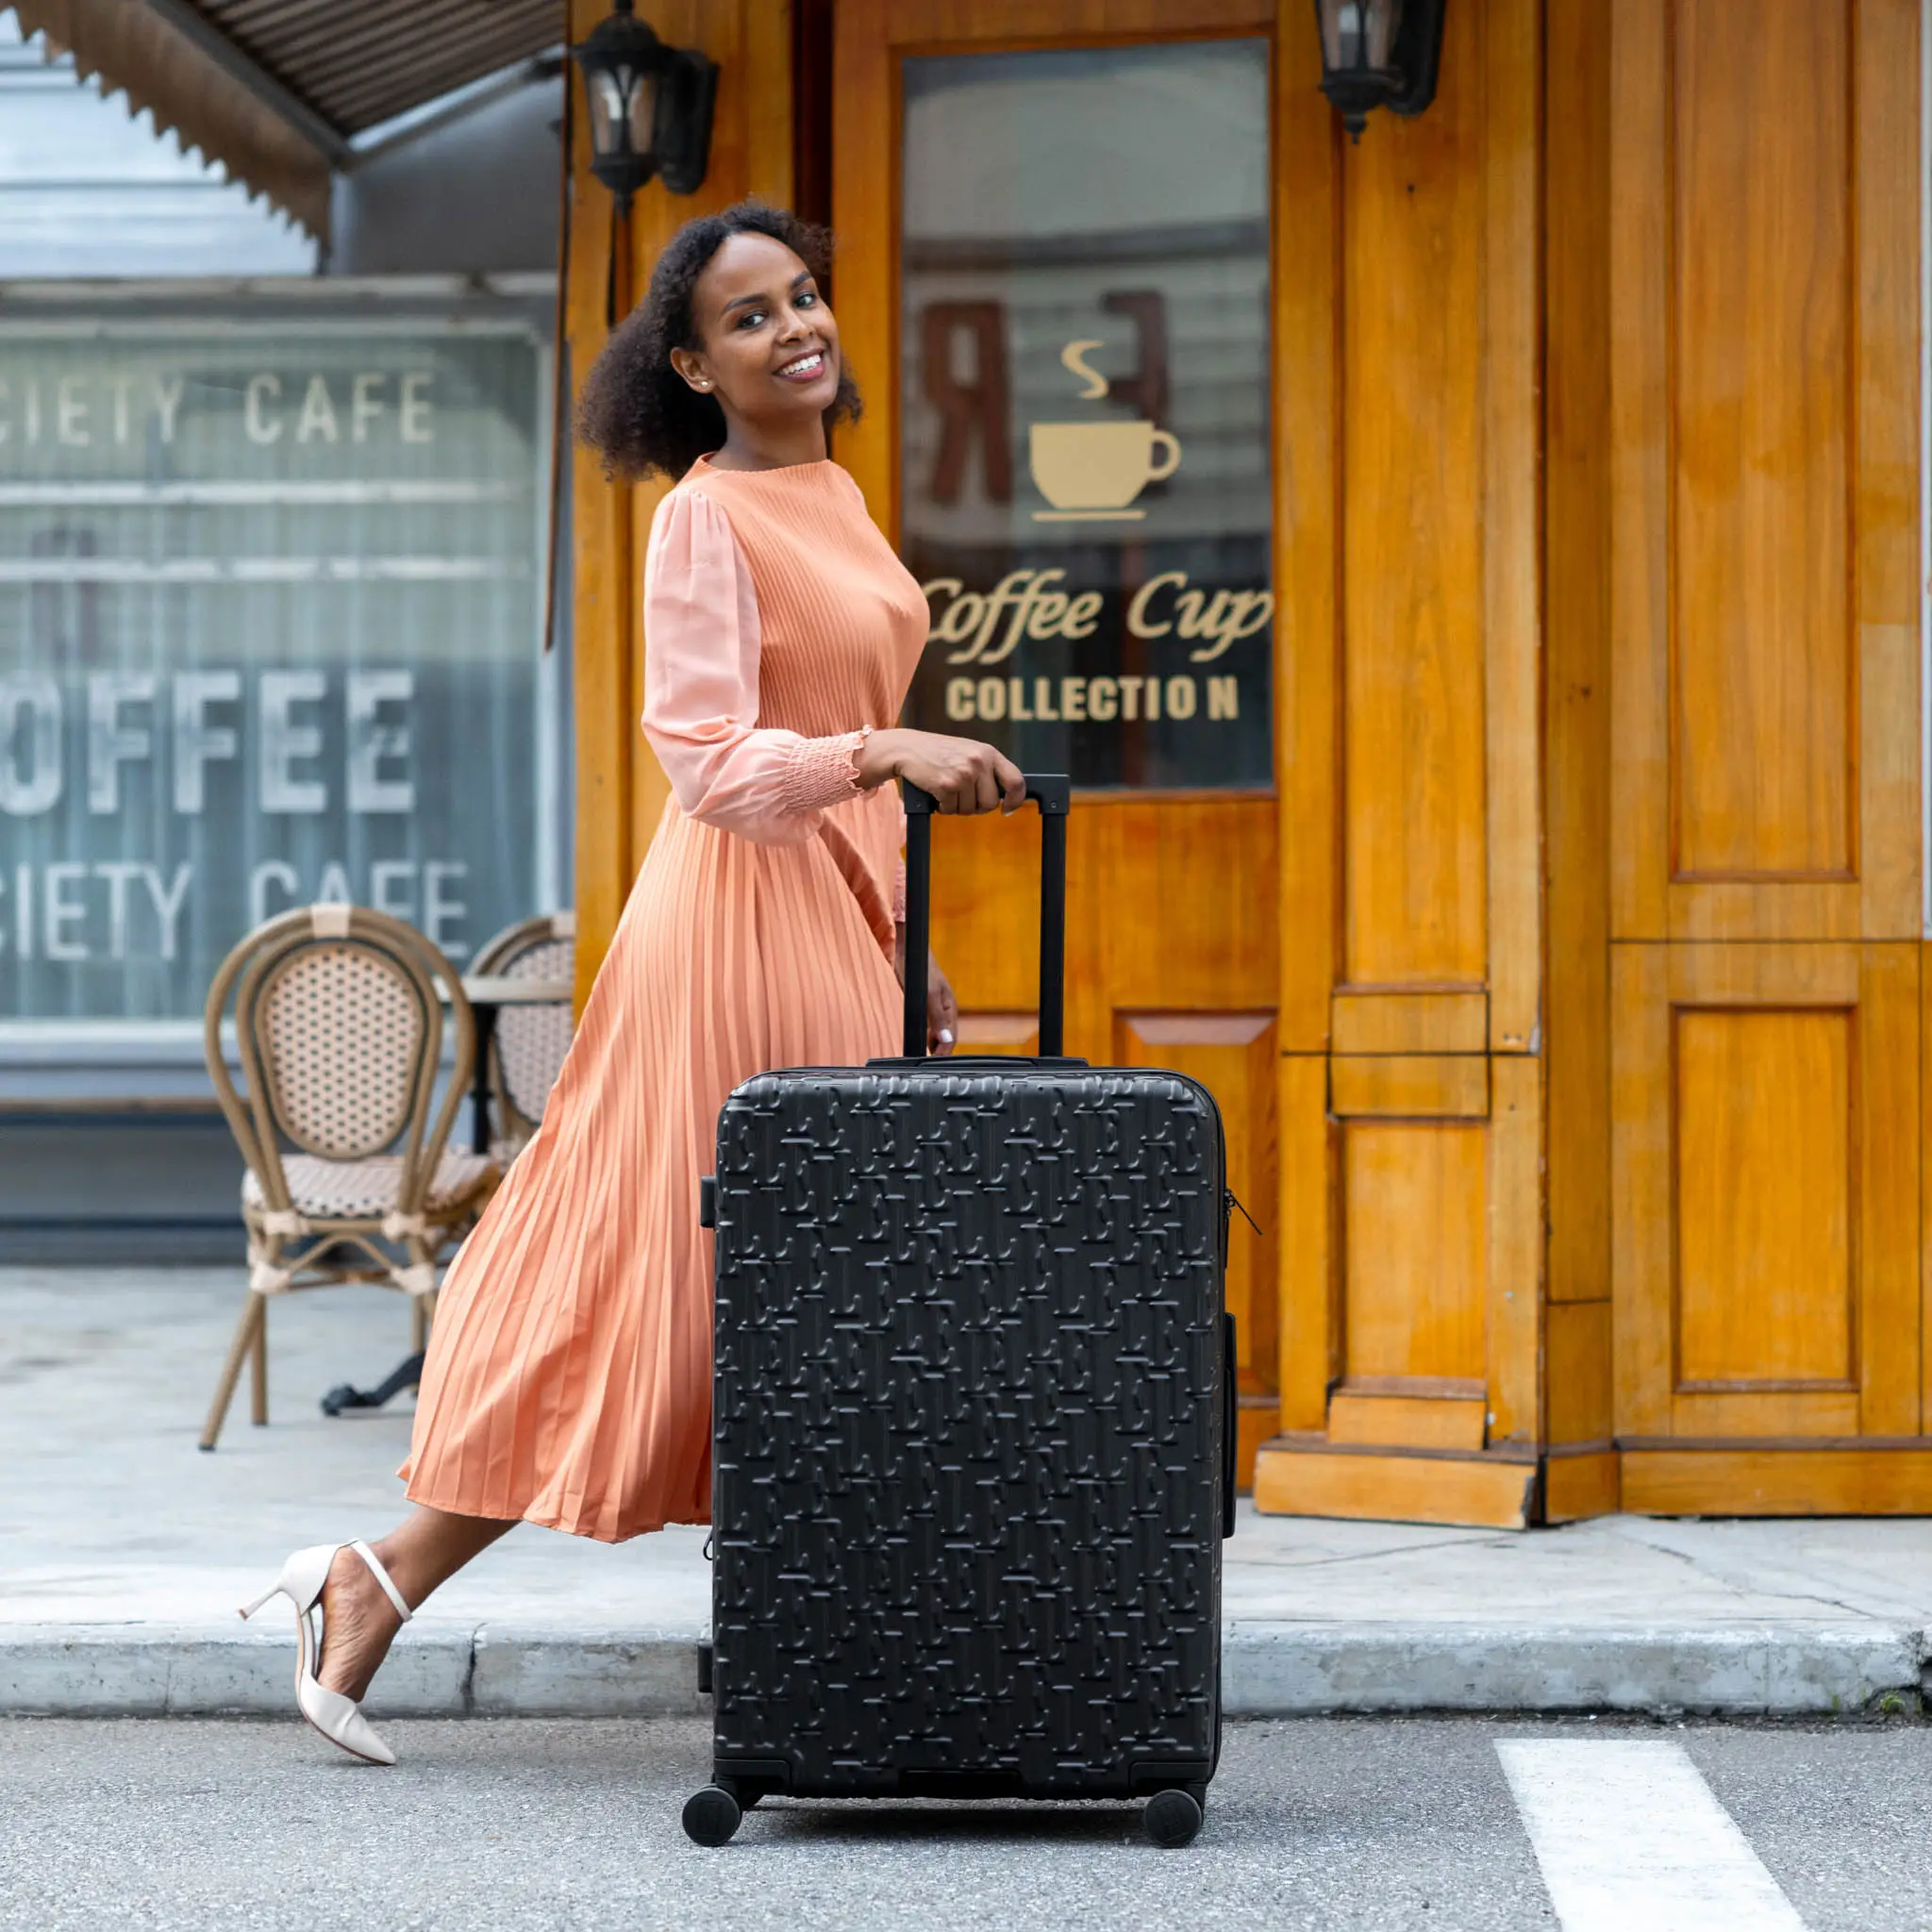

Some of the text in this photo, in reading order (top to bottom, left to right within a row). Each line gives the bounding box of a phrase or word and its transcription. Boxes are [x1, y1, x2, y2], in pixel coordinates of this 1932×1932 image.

[0, 374, 435, 446] IETY CAFE
[920, 568, 1274, 664] Coffee Cup
[0, 671, 415, 816] OFFEE
[945, 675, 1239, 721] COLLECTION
[0, 861, 194, 961] IETY
